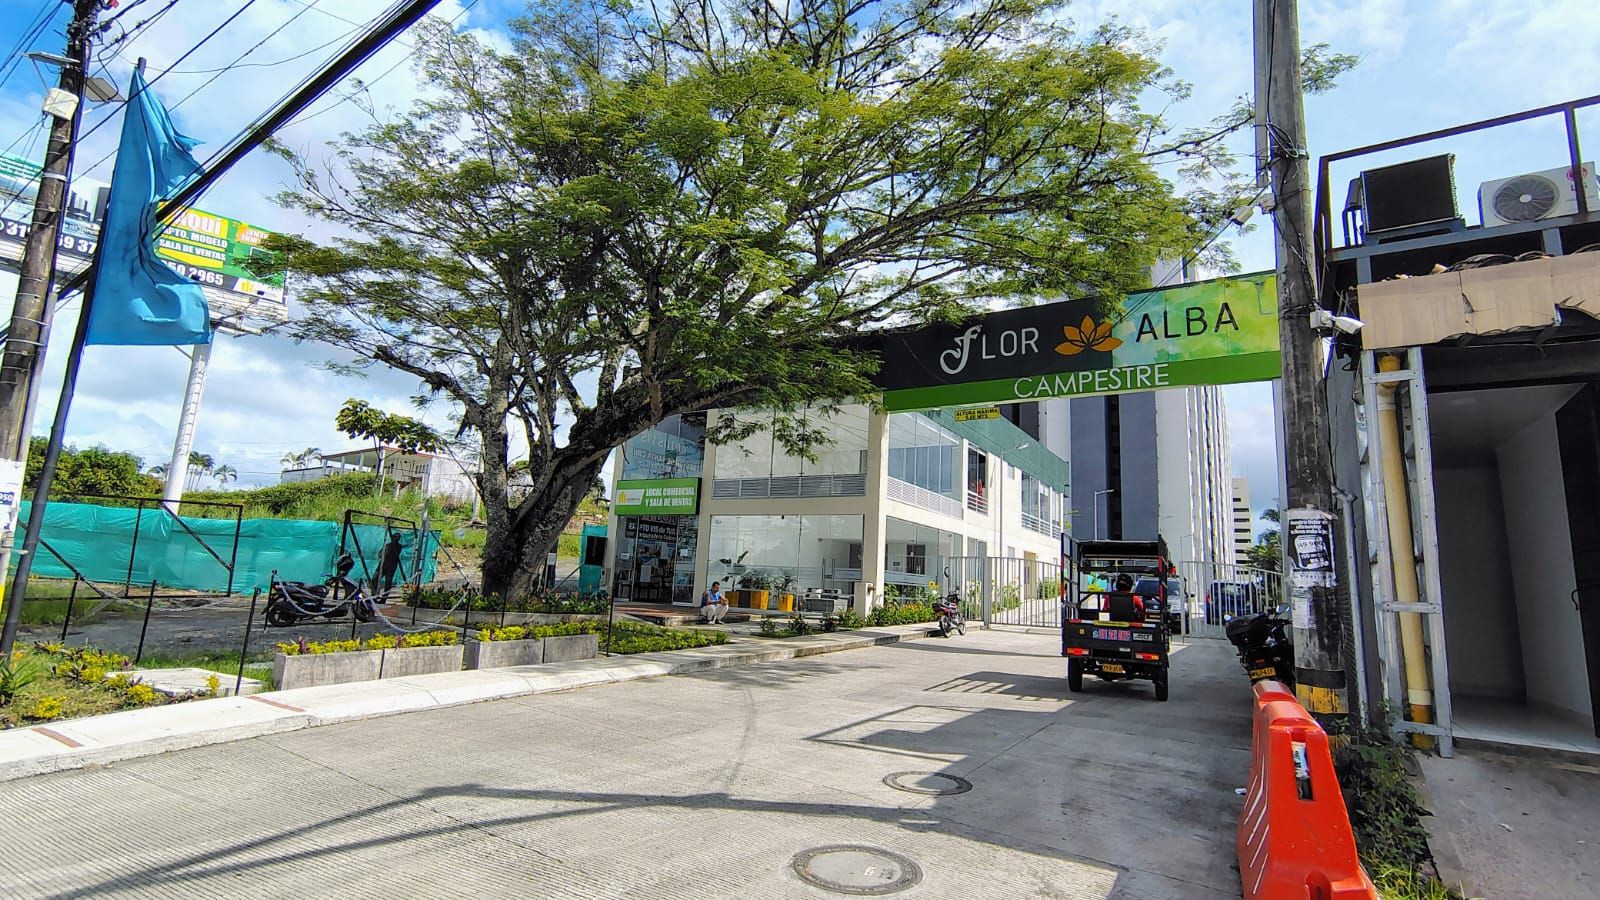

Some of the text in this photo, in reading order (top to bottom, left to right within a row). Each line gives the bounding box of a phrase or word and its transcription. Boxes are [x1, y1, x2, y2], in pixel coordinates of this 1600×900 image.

[159, 238, 226, 261] SALA DE VENTAS
[190, 232, 228, 248] MODELO
[939, 302, 1239, 375] FLOR ALBA
[1014, 363, 1170, 398] CAMPESTRE
[645, 487, 695, 497] LOCAL COMERCIAL
[649, 498, 663, 507] SALA
[663, 498, 671, 507] DE
[671, 497, 693, 506] VENTAS
